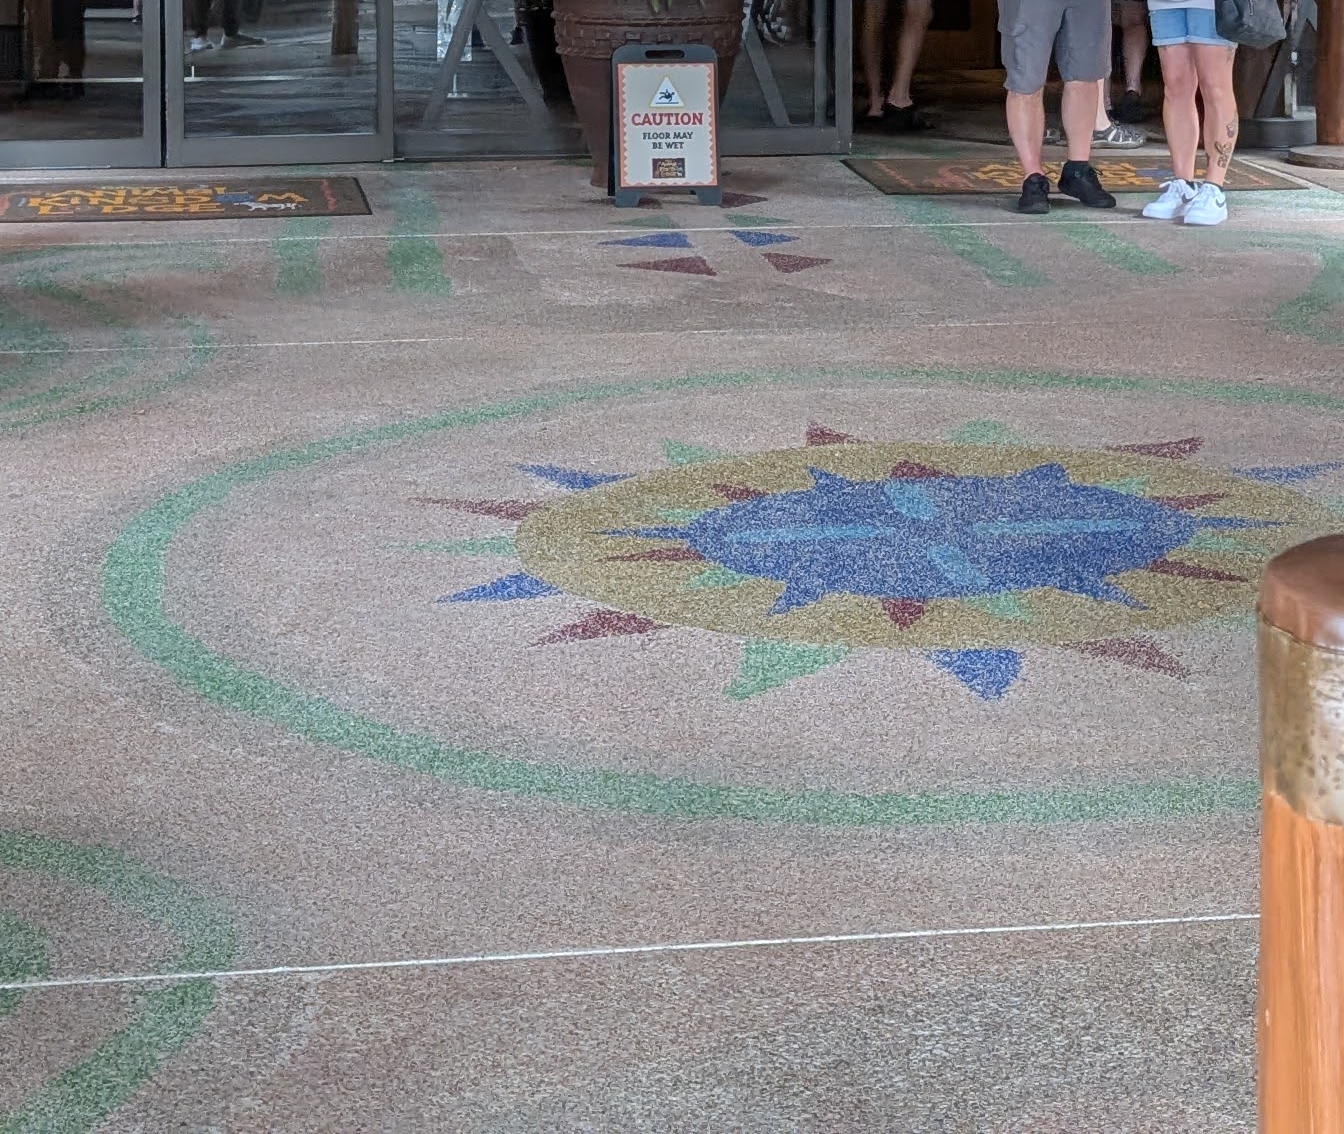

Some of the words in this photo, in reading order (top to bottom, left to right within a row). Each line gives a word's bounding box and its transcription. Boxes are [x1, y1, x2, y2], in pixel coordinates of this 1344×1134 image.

[631, 112, 704, 126] CAUTION
[642, 132, 671, 140] FLOOR
[673, 131, 694, 140] MAY
[28, 192, 309, 207] KINGDM
[38, 203, 226, 215] LDGE
